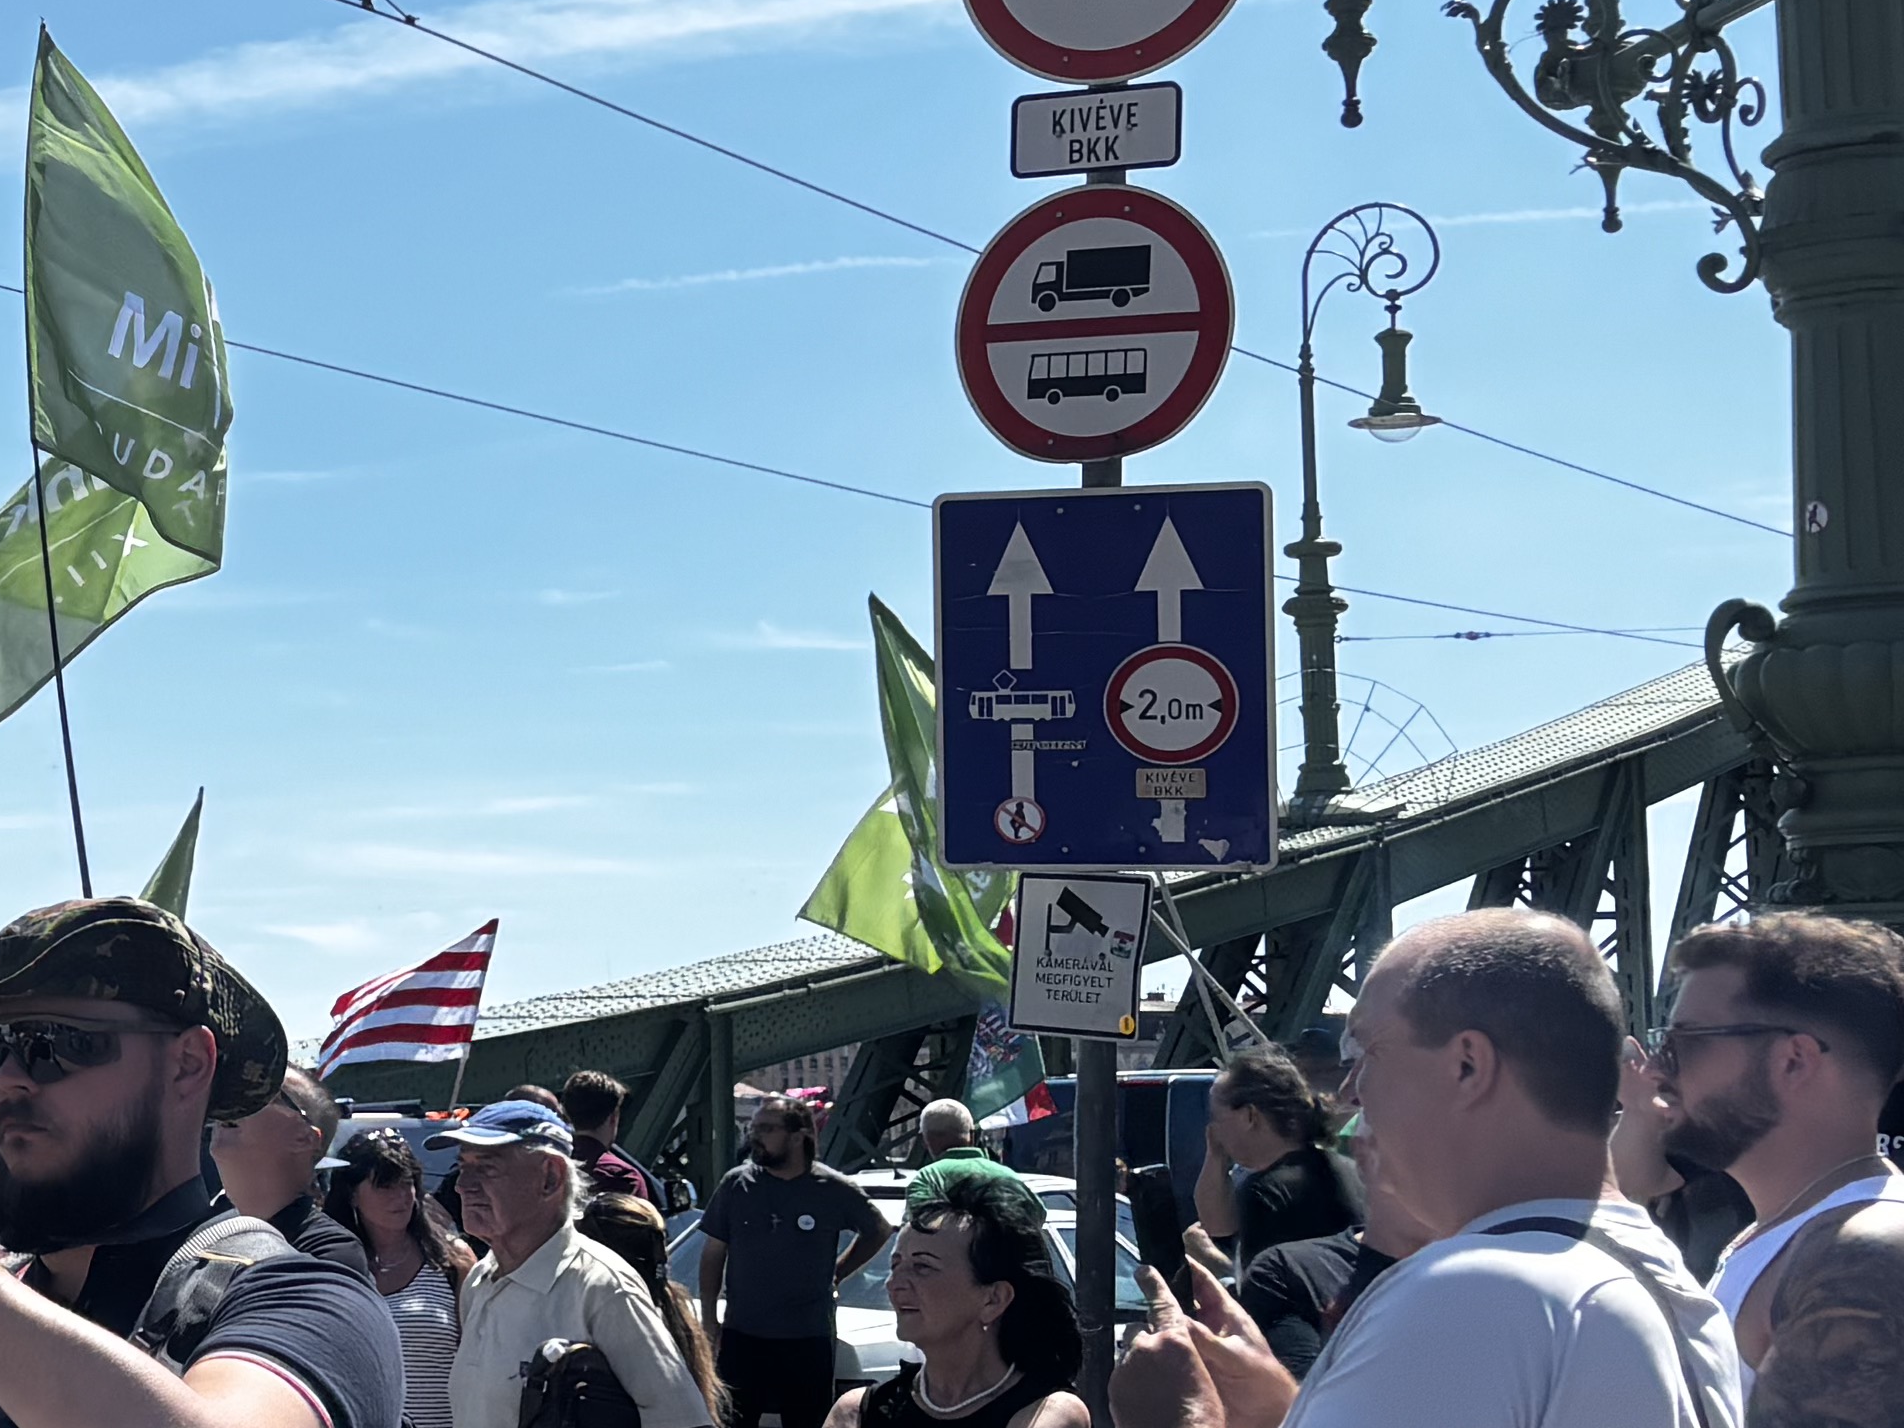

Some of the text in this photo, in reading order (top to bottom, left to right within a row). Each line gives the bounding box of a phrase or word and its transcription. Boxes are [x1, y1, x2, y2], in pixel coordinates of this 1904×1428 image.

[1052, 98, 1139, 136] KIVÉVE
[1069, 135, 1119, 164] BKK
[1138, 688, 1204, 725] 2,0m
[1145, 770, 1196, 784] KIVÉVE
[1154, 785, 1184, 797] BKK
[1036, 955, 1114, 973] KAMERÁVAL
[1035, 972, 1114, 989] MEGFIGYELT
[1045, 988, 1102, 1004] TERÜLET
